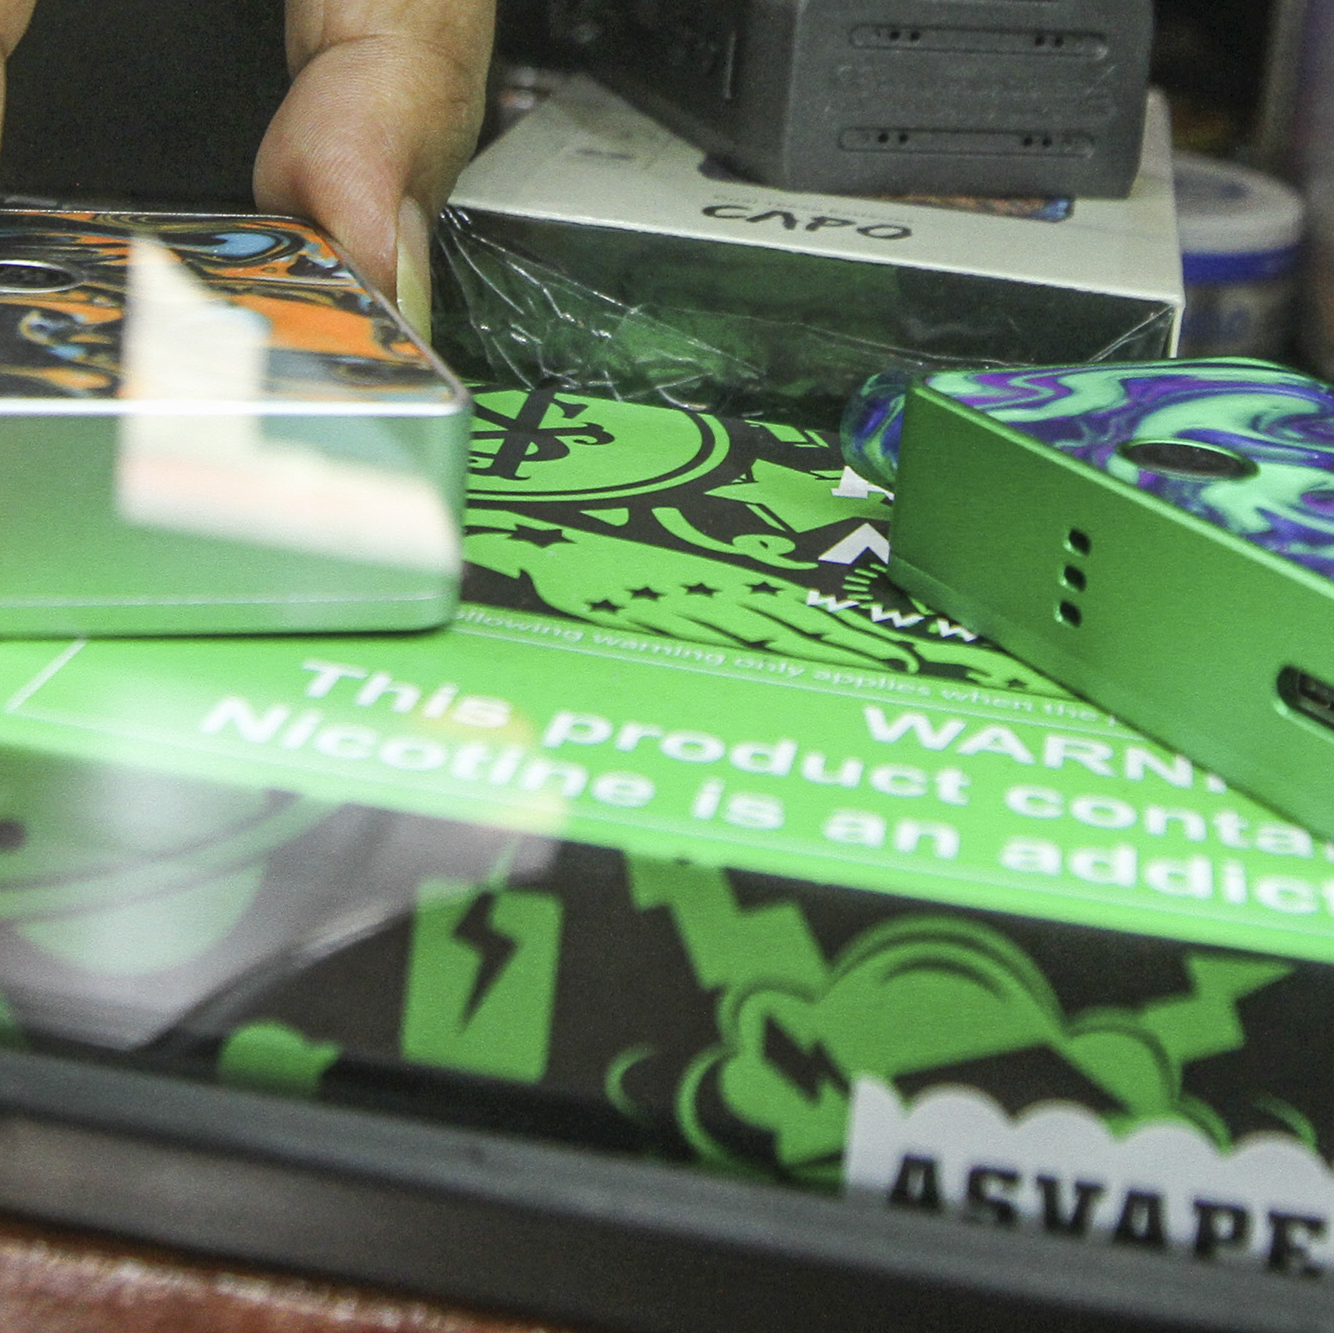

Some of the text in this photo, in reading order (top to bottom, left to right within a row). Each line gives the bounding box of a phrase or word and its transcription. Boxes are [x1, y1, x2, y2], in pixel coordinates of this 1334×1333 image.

[701, 204, 913, 240] CAPO
[591, 631, 727, 667] warning
[197, 695, 656, 809] Nicotine
[691, 777, 786, 832] is
[821, 808, 962, 862] an
[300, 658, 513, 729] This
[541, 709, 970, 807] product
[885, 1152, 1328, 1279] ASVAPE
